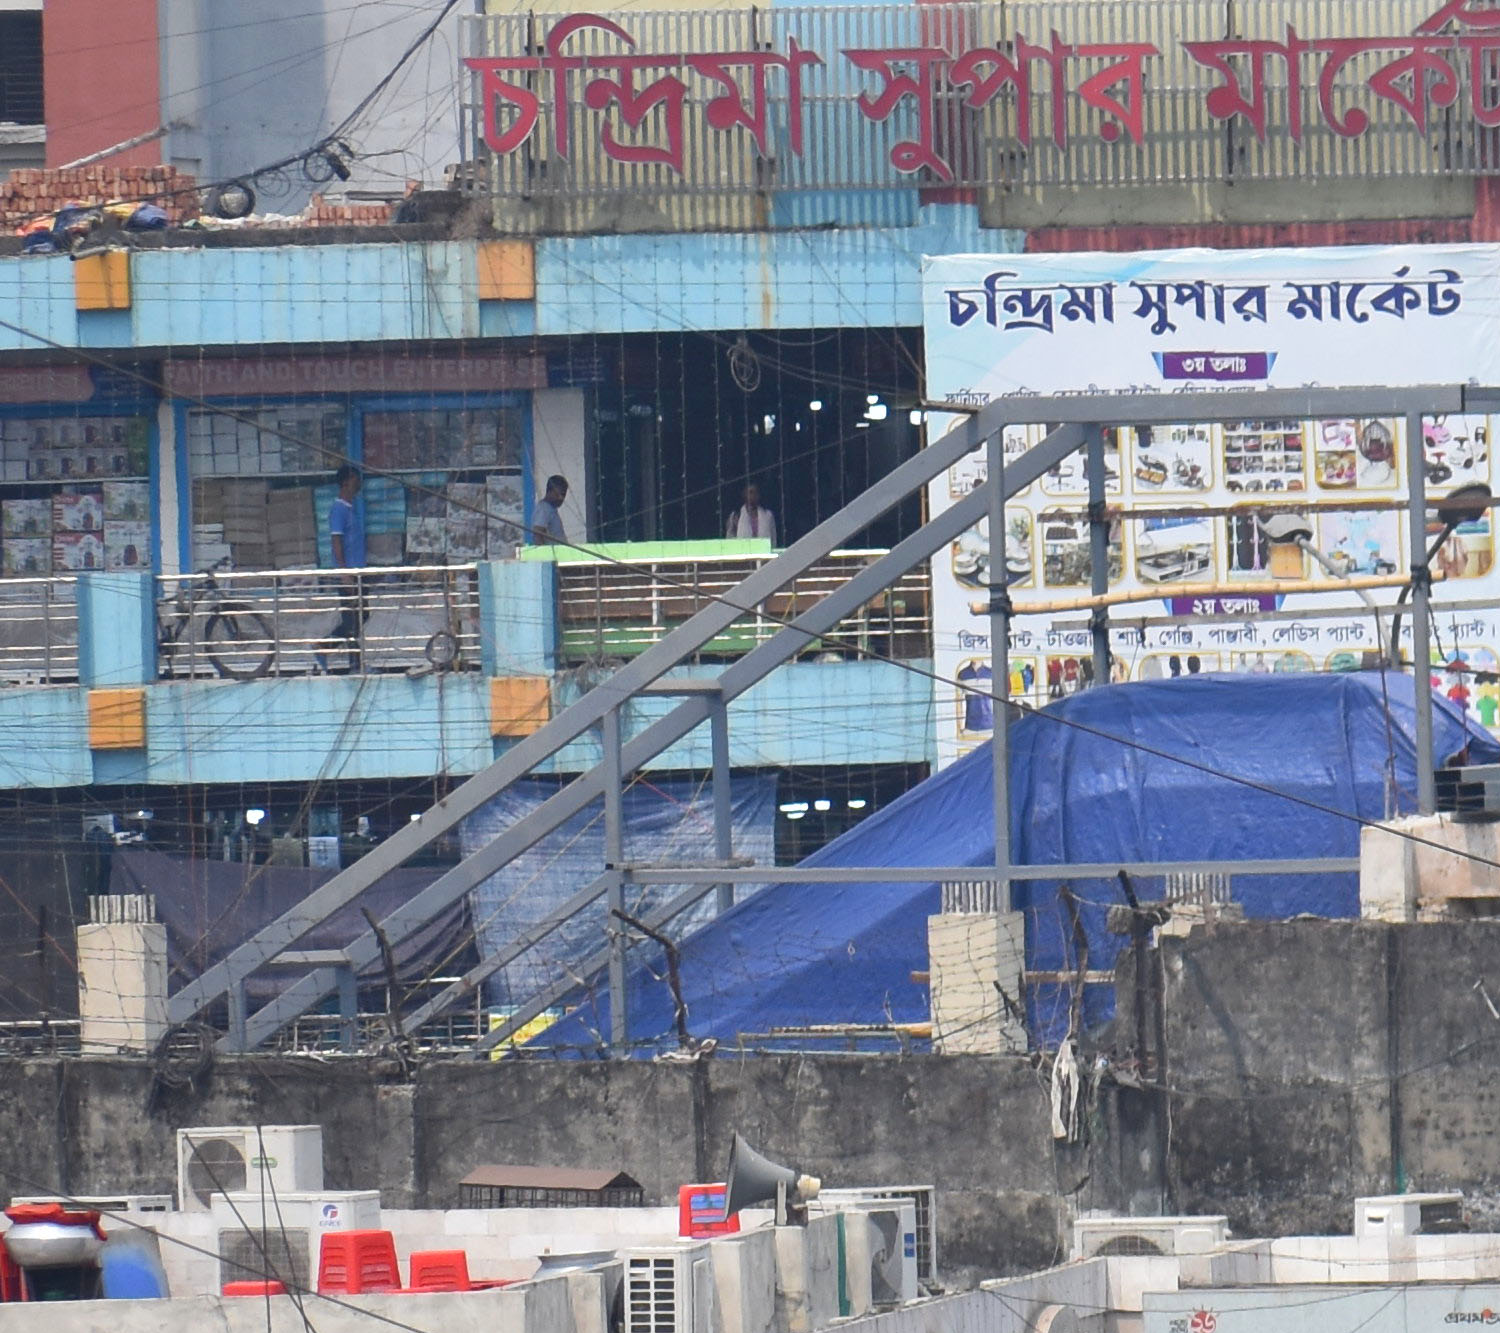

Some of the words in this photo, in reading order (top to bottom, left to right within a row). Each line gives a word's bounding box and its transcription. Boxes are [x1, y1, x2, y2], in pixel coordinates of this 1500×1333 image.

[463, 12, 820, 174] চন্দ্রিমা
[842, 30, 1161, 181] সুপার
[944, 272, 1117, 332] চন্দ্রিমা
[1131, 276, 1268, 334] সুপার
[1285, 265, 1462, 322] মার্কেট
[240, 358, 289, 383] AND
[302, 359, 386, 380] TOUCH
